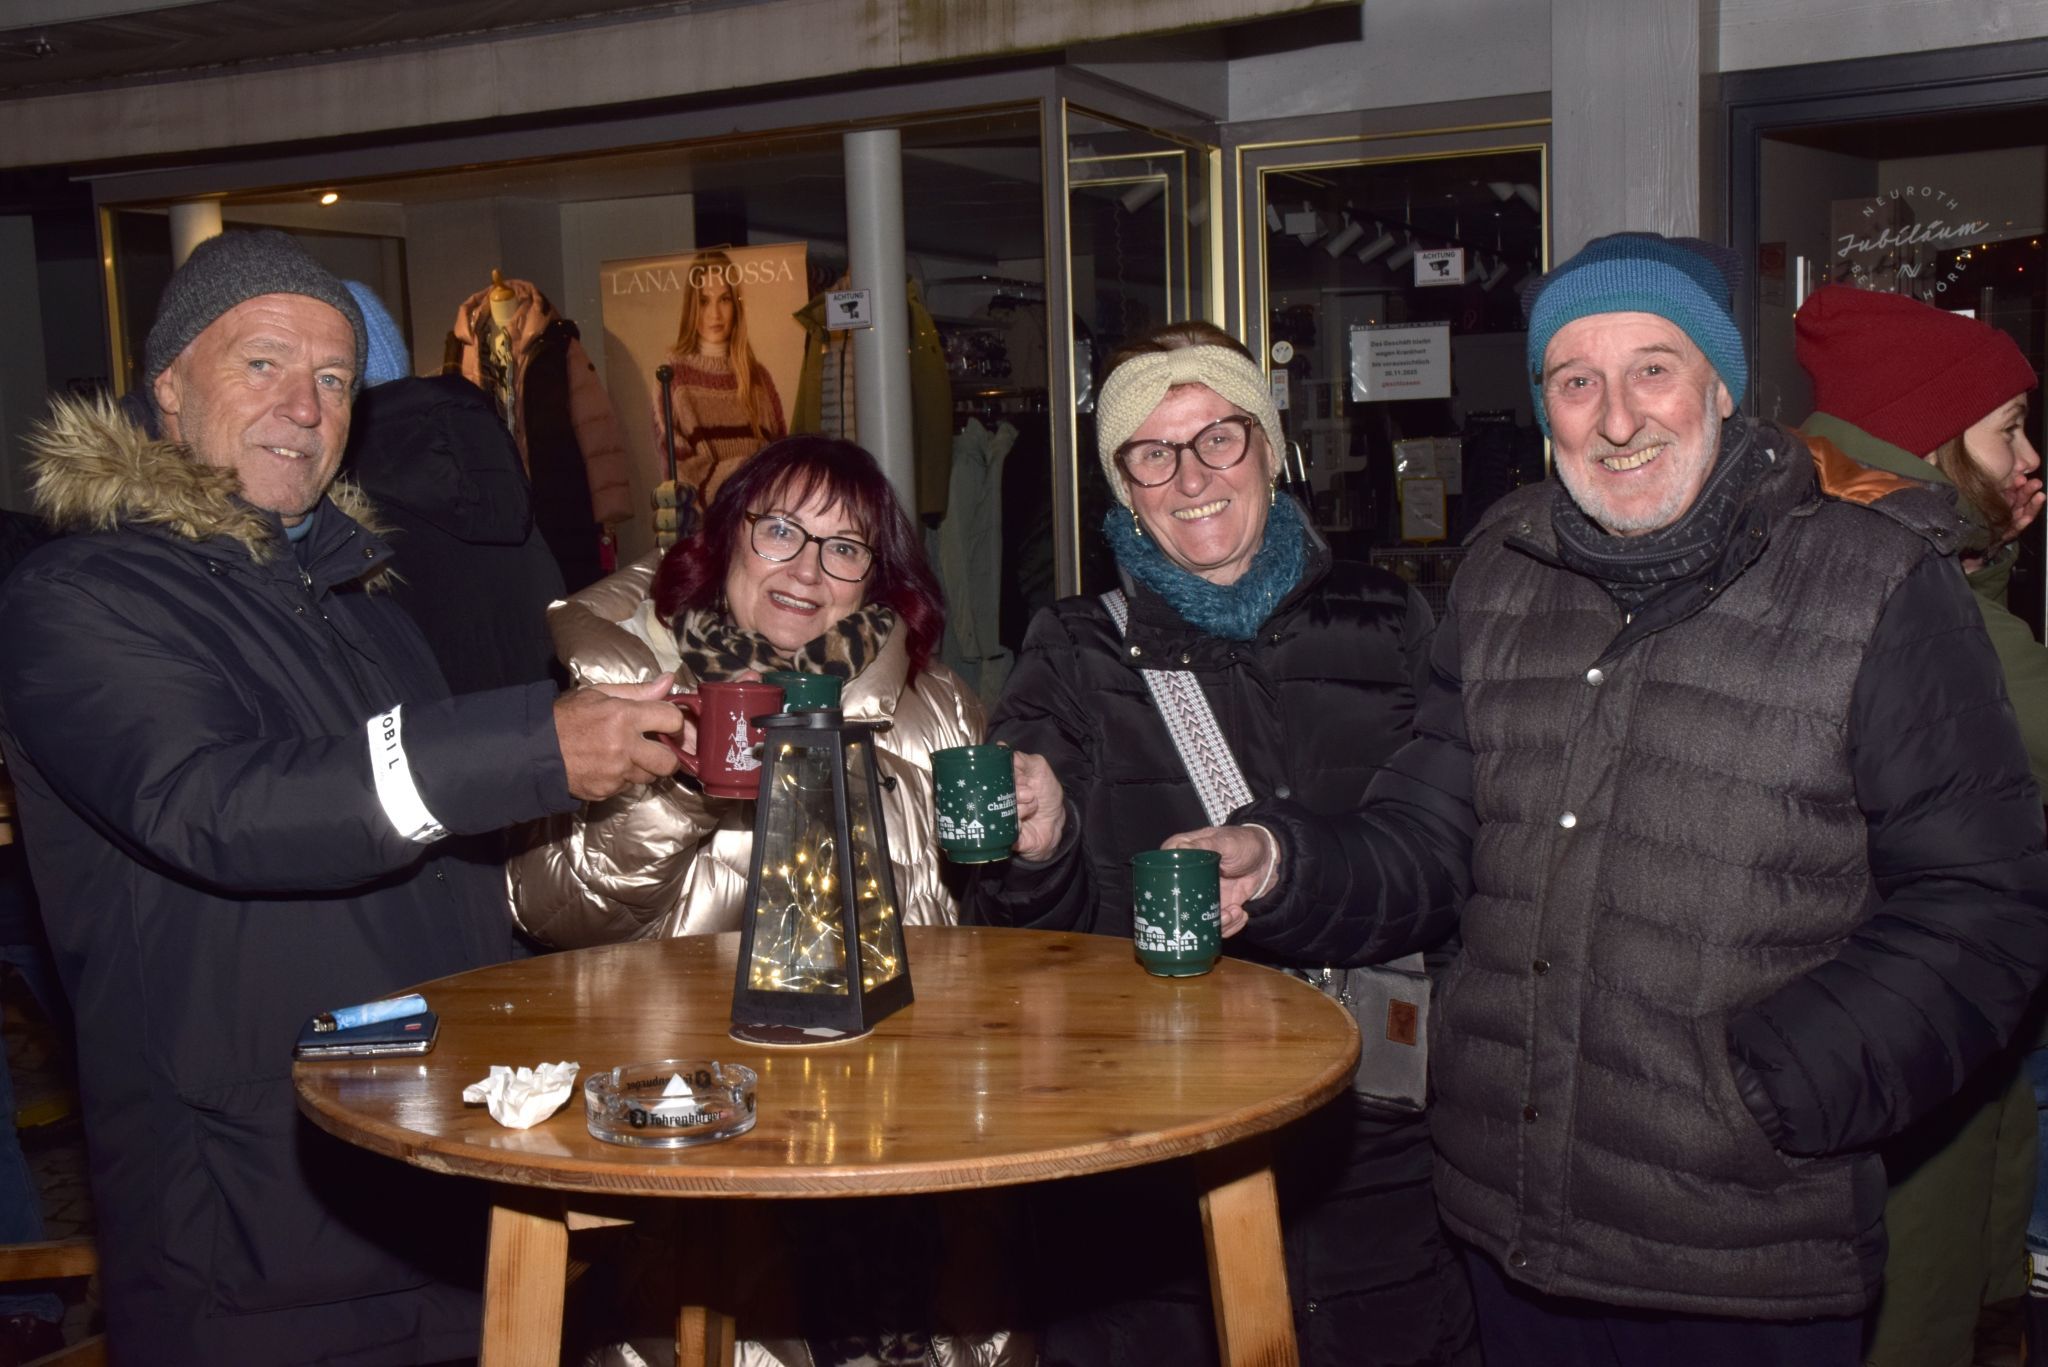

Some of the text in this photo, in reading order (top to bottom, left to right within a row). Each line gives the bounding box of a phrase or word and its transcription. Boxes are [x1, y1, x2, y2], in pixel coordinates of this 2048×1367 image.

[1862, 185, 1959, 217] NEUROTH
[1422, 251, 1456, 260] ACHTUNG
[1837, 220, 1990, 258] Jubiläum
[611, 258, 794, 295] LANA GROSSA
[833, 292, 864, 300] ACHTUNG
[381, 711, 400, 770] OBIL
